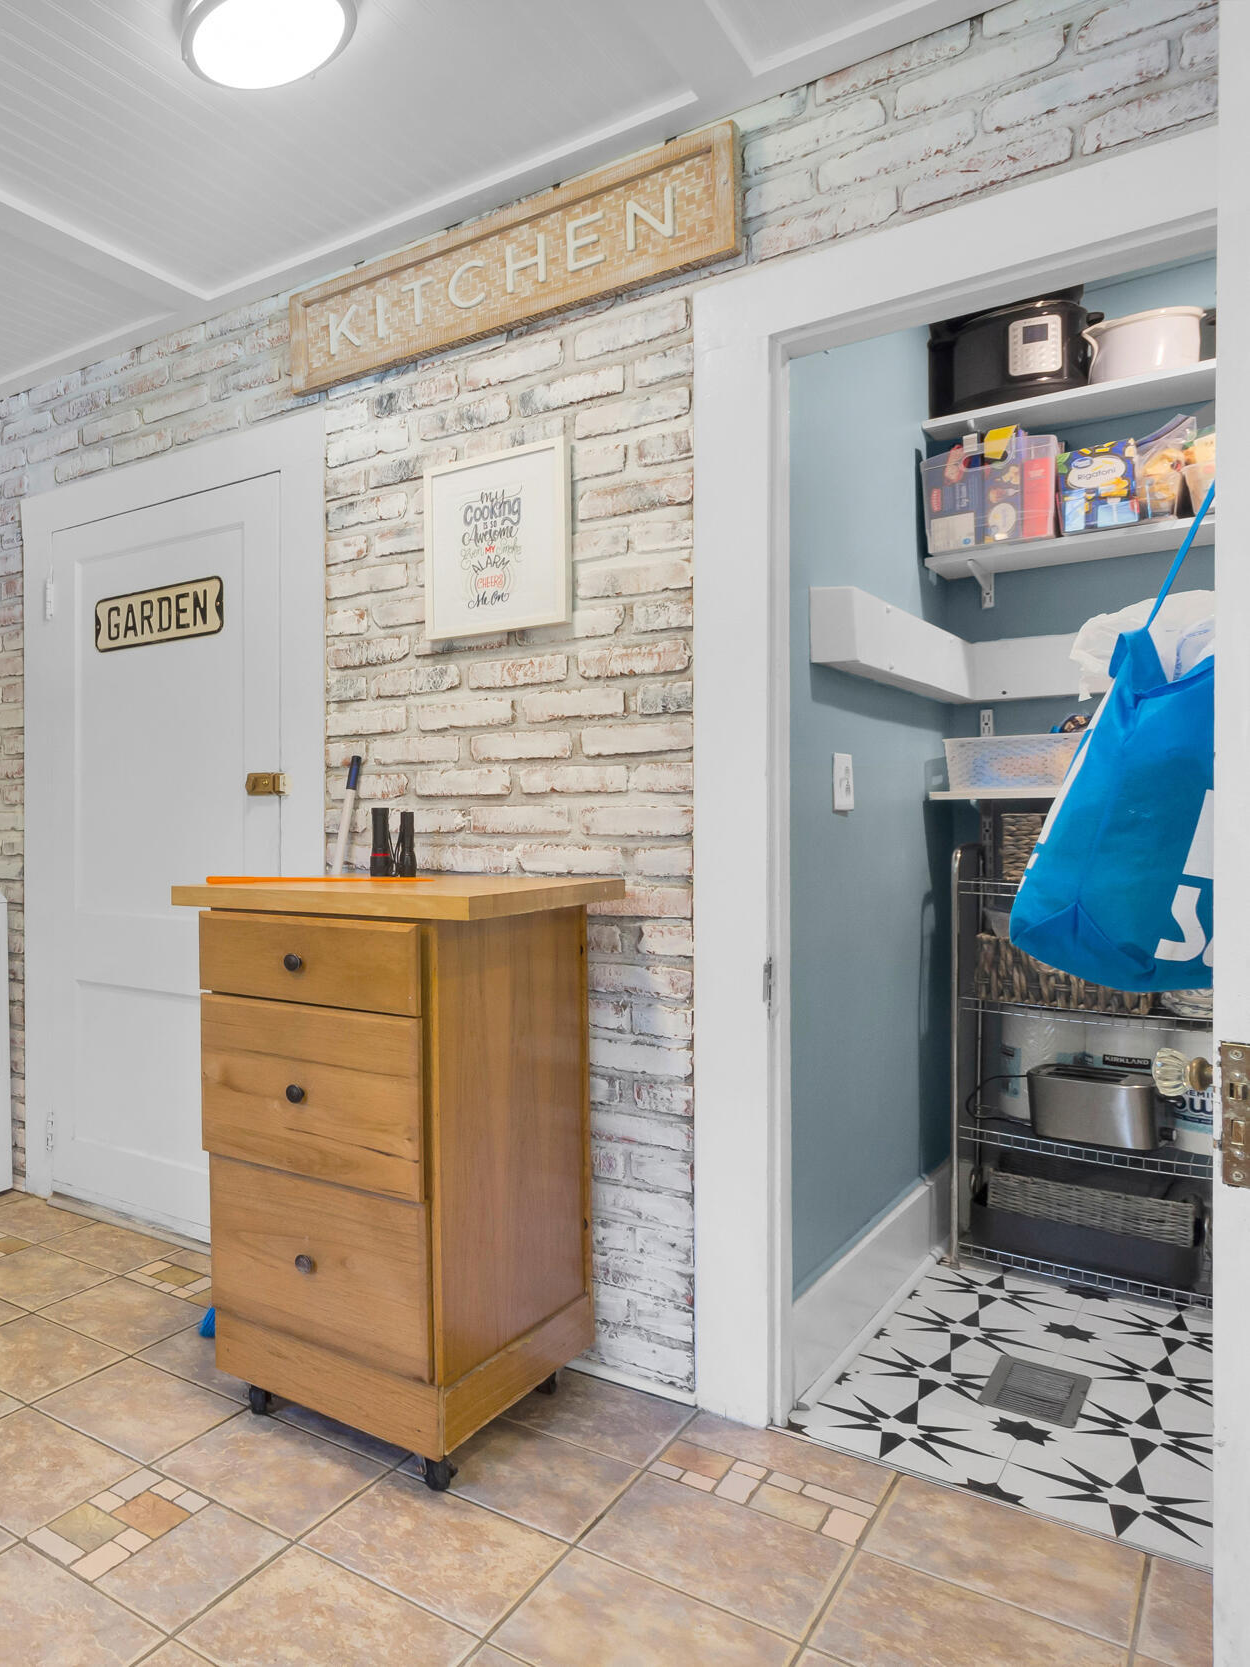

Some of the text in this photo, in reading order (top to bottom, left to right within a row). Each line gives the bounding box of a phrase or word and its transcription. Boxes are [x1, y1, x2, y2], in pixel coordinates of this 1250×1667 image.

[328, 184, 678, 357] KITCHEN
[1077, 467, 1116, 481] Rigatoni
[463, 496, 522, 527] Cooking
[461, 524, 519, 548] Awesome
[471, 554, 511, 576] ALARM
[476, 573, 504, 590] CHEERS
[107, 588, 208, 642] GARDEN
[1104, 1056, 1150, 1067] KIRKLAND
